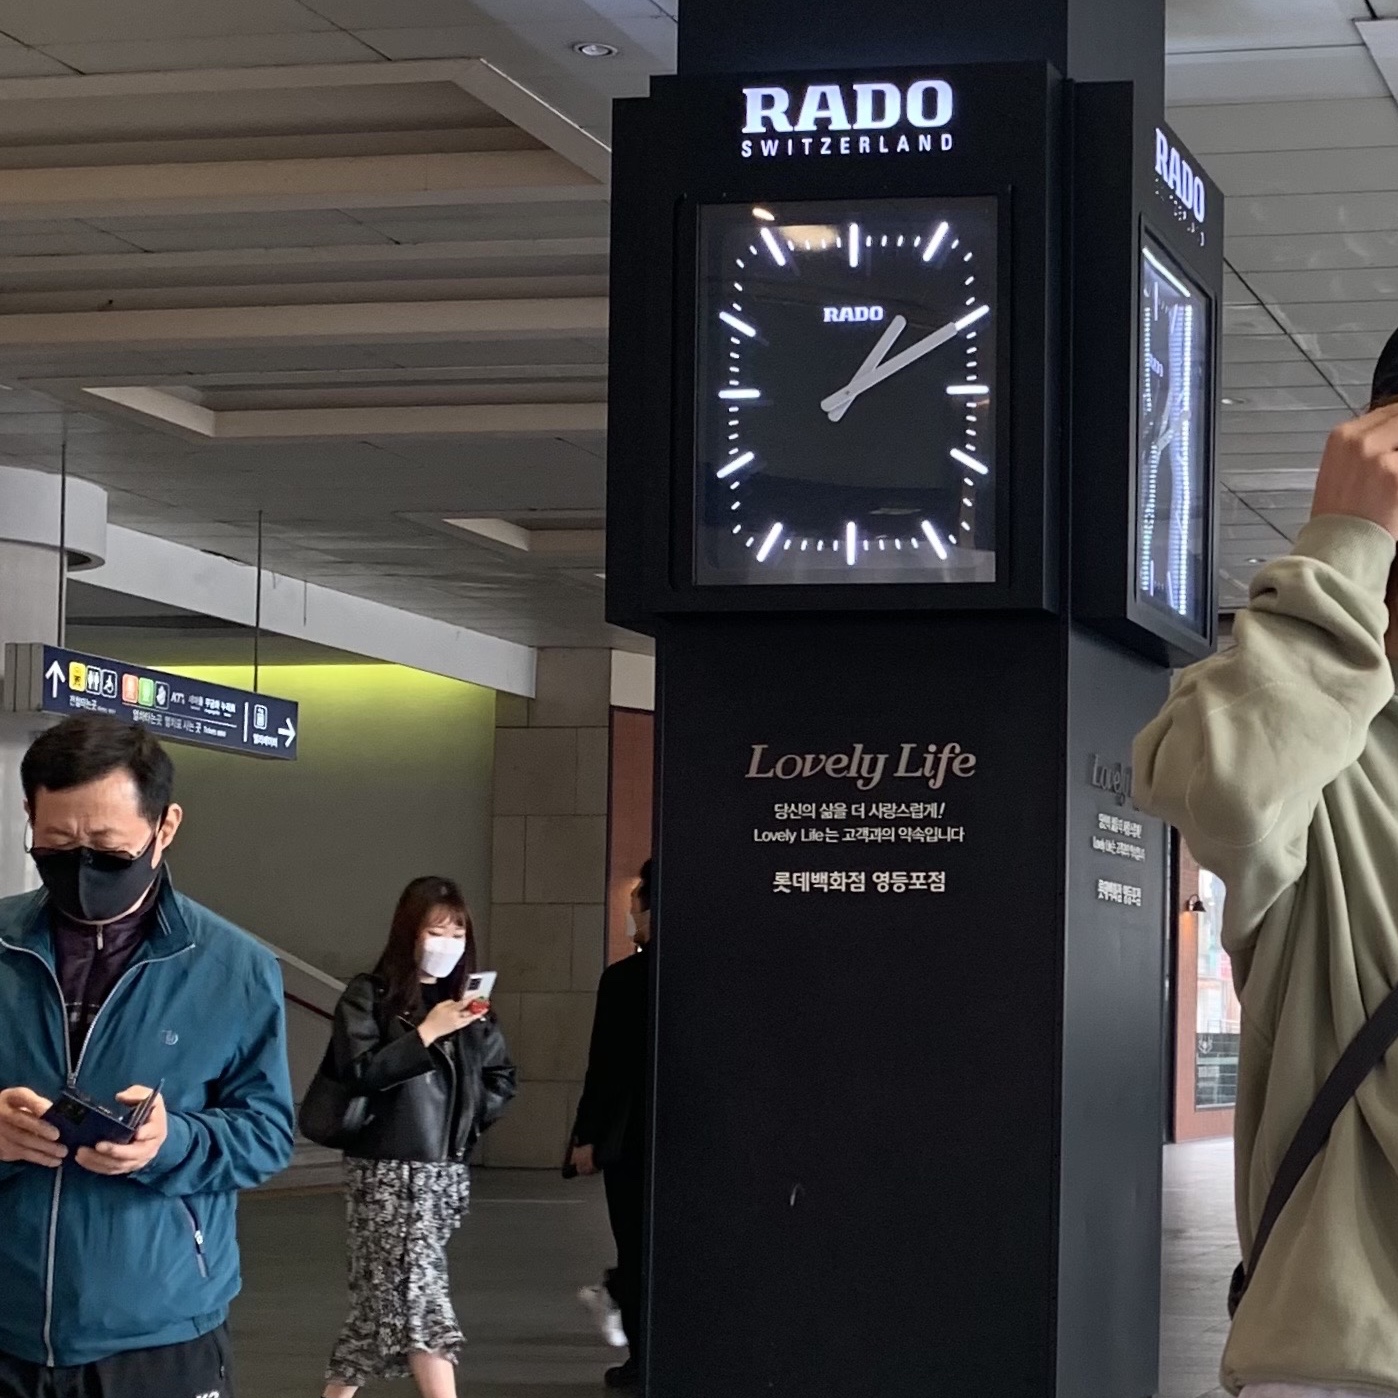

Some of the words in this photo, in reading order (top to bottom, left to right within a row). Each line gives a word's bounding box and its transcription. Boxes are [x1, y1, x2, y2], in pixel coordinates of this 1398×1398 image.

[741, 79, 953, 133] RADO
[741, 134, 953, 157] SWITZERLAND
[1154, 127, 1205, 223] RADO
[823, 305, 884, 322] RADO
[745, 743, 888, 790] Lovely
[893, 743, 977, 789] Life
[774, 802, 816, 820] 당신의
[819, 802, 848, 819] 삶을
[851, 803, 866, 819] 더
[868, 802, 946, 819] 사랑스럽게!
[753, 828, 797, 844] Lovely
[801, 827, 840, 843] Life는
[841, 826, 896, 843] 고객과의
[897, 826, 965, 843] 약속입니다
[773, 871, 866, 893] 롯데백화점
[872, 870, 946, 893] 영등포점
